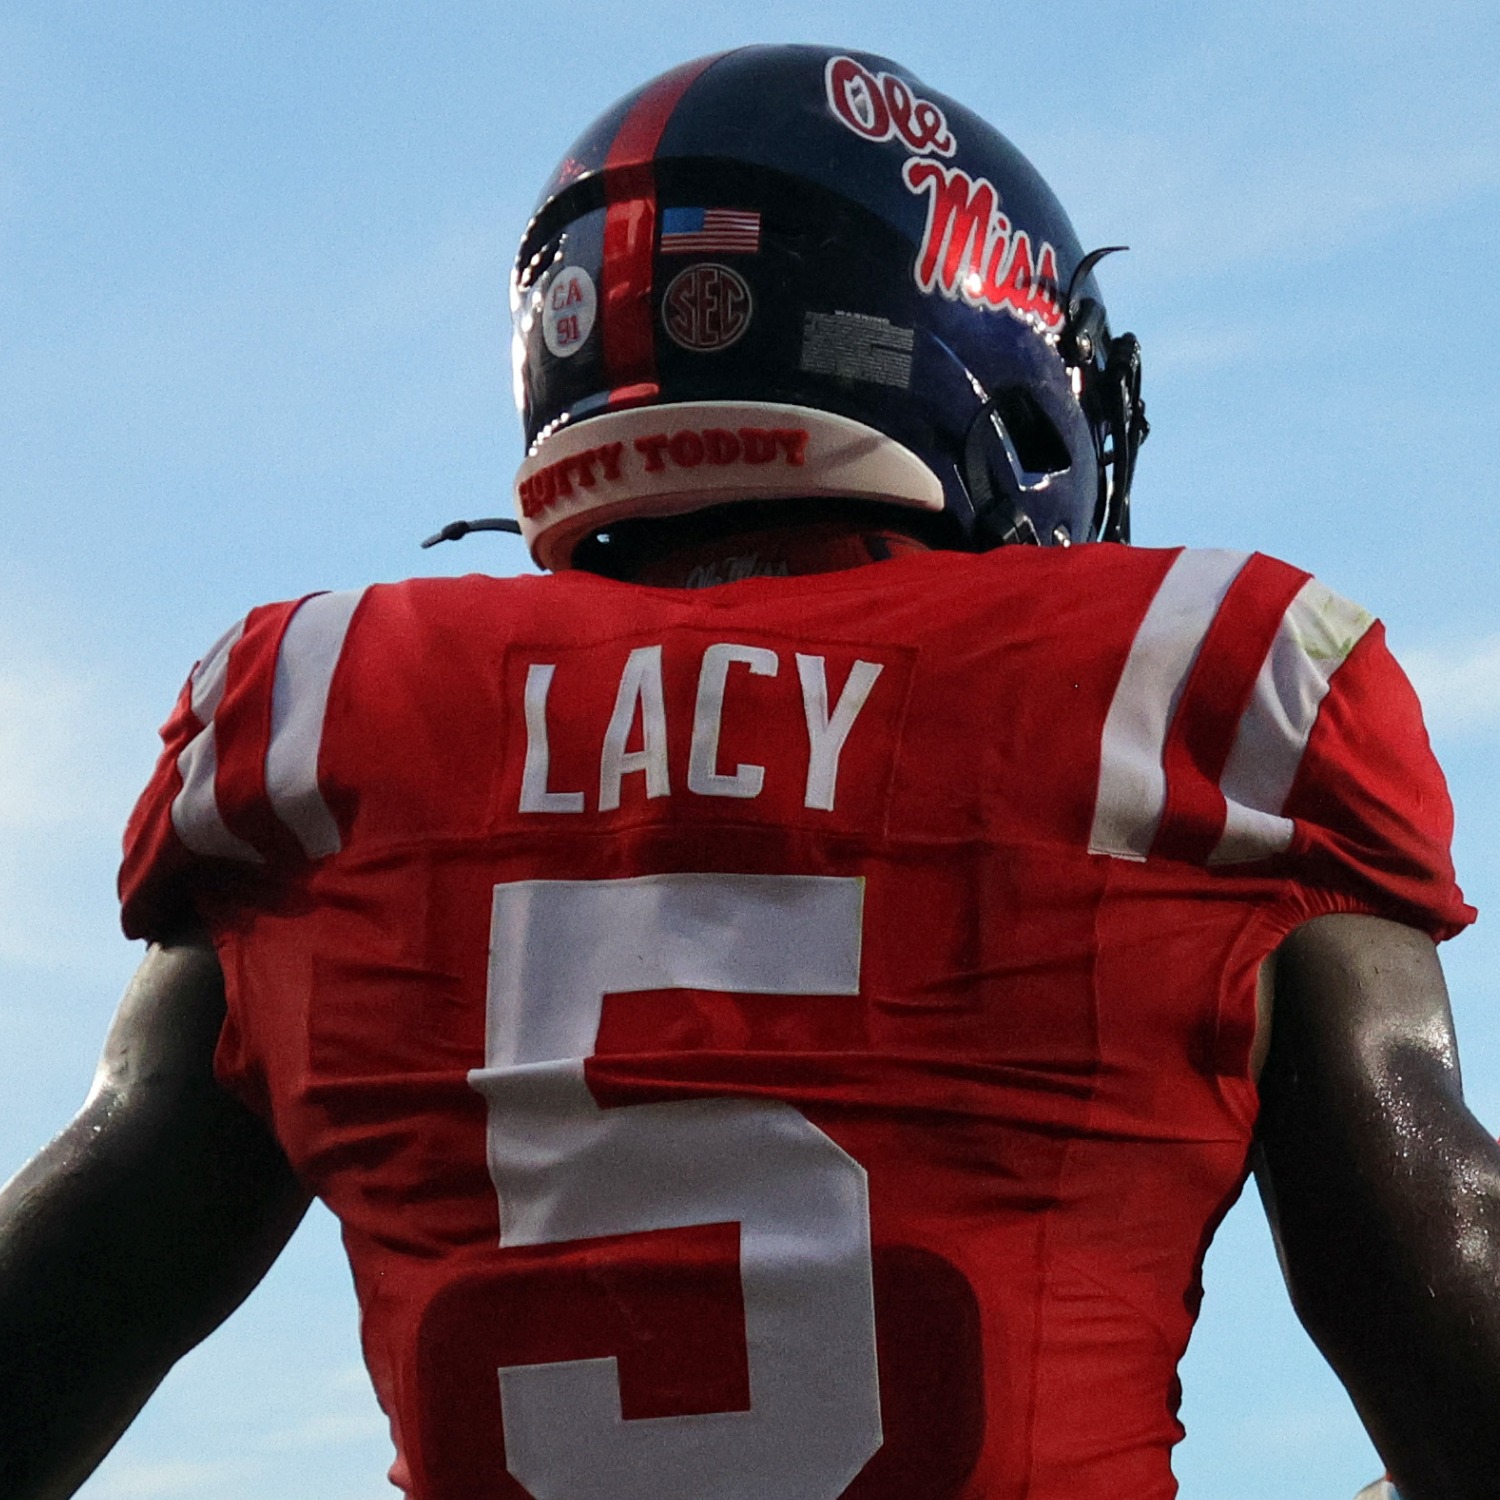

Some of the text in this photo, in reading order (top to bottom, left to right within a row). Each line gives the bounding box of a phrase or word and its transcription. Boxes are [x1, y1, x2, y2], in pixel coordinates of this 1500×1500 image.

[825, 56, 956, 157] Ole
[902, 157, 1065, 333] Miss
[556, 319, 581, 346] 91
[667, 267, 750, 348] SEC
[633, 427, 810, 473] TODDY
[518, 643, 885, 814] LACY
